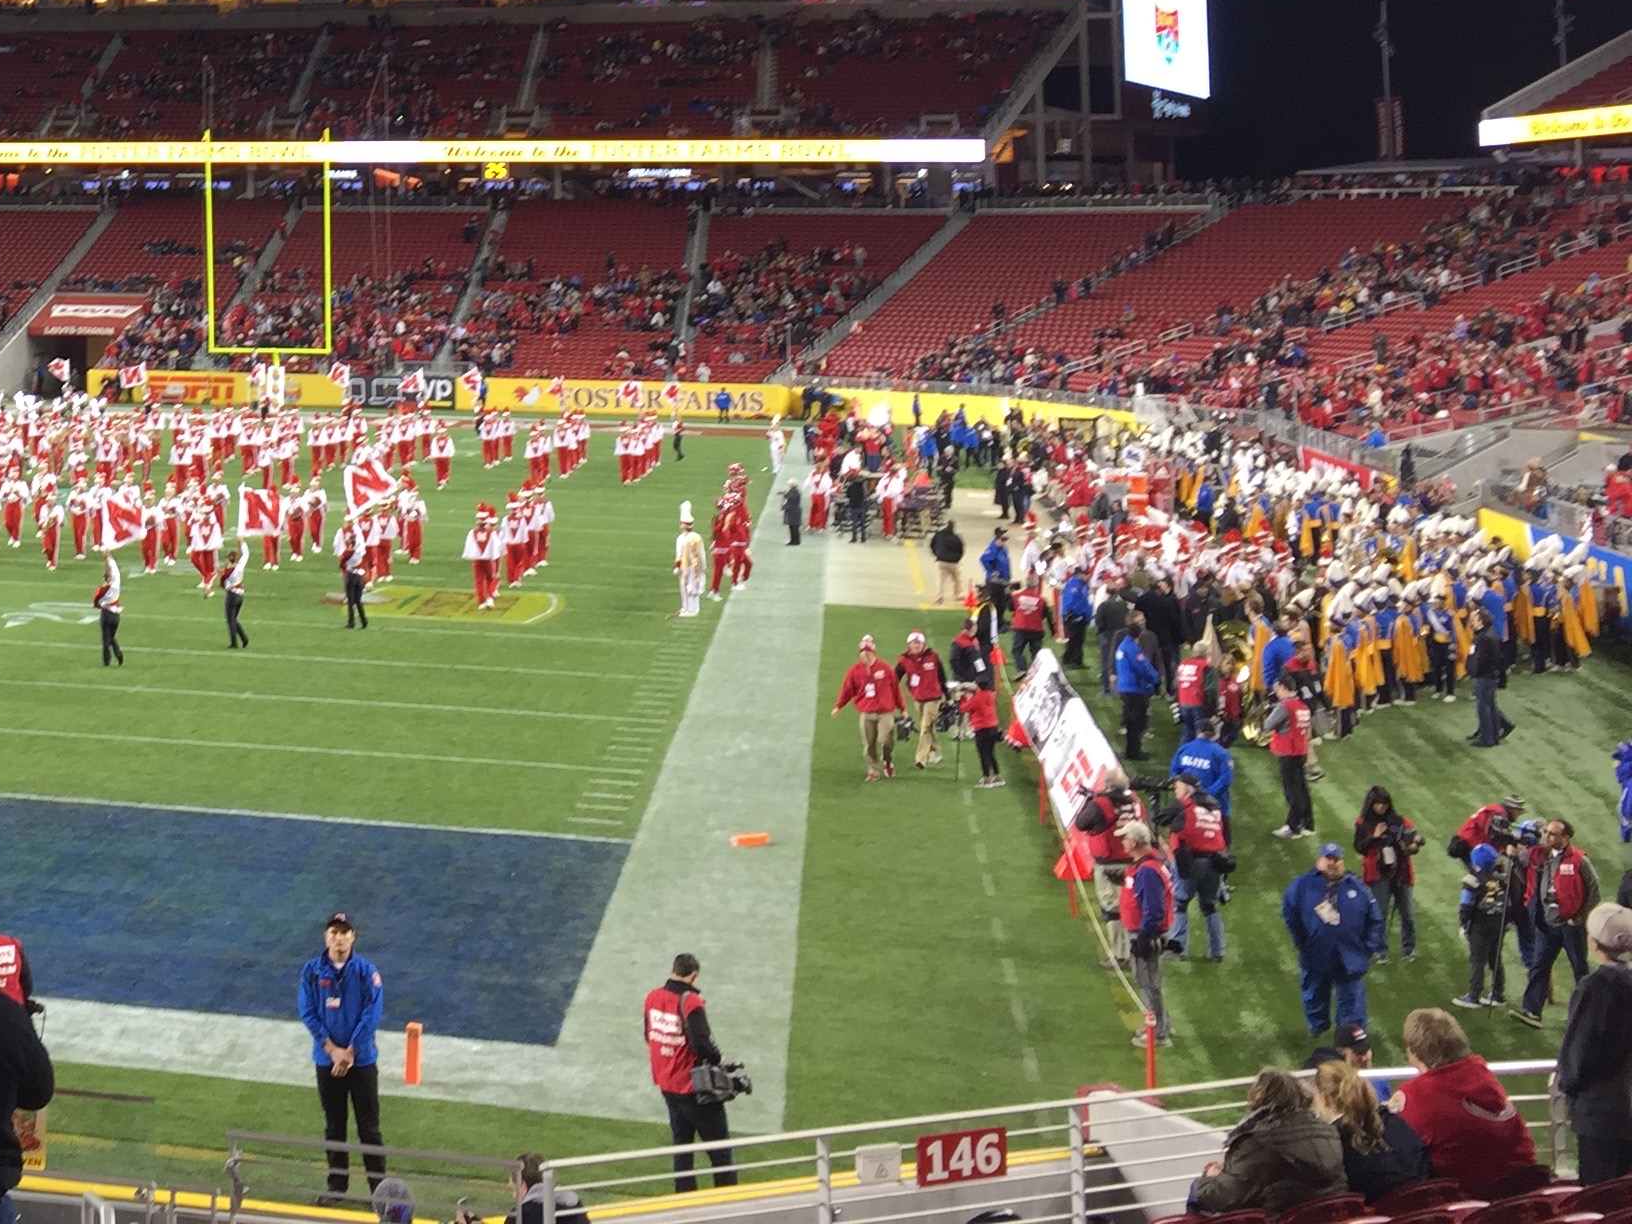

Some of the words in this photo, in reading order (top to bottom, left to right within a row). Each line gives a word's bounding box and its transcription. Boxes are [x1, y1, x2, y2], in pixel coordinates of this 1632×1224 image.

[443, 144, 527, 159] Welcome
[242, 488, 281, 530] N
[926, 1132, 1002, 1182] 146
